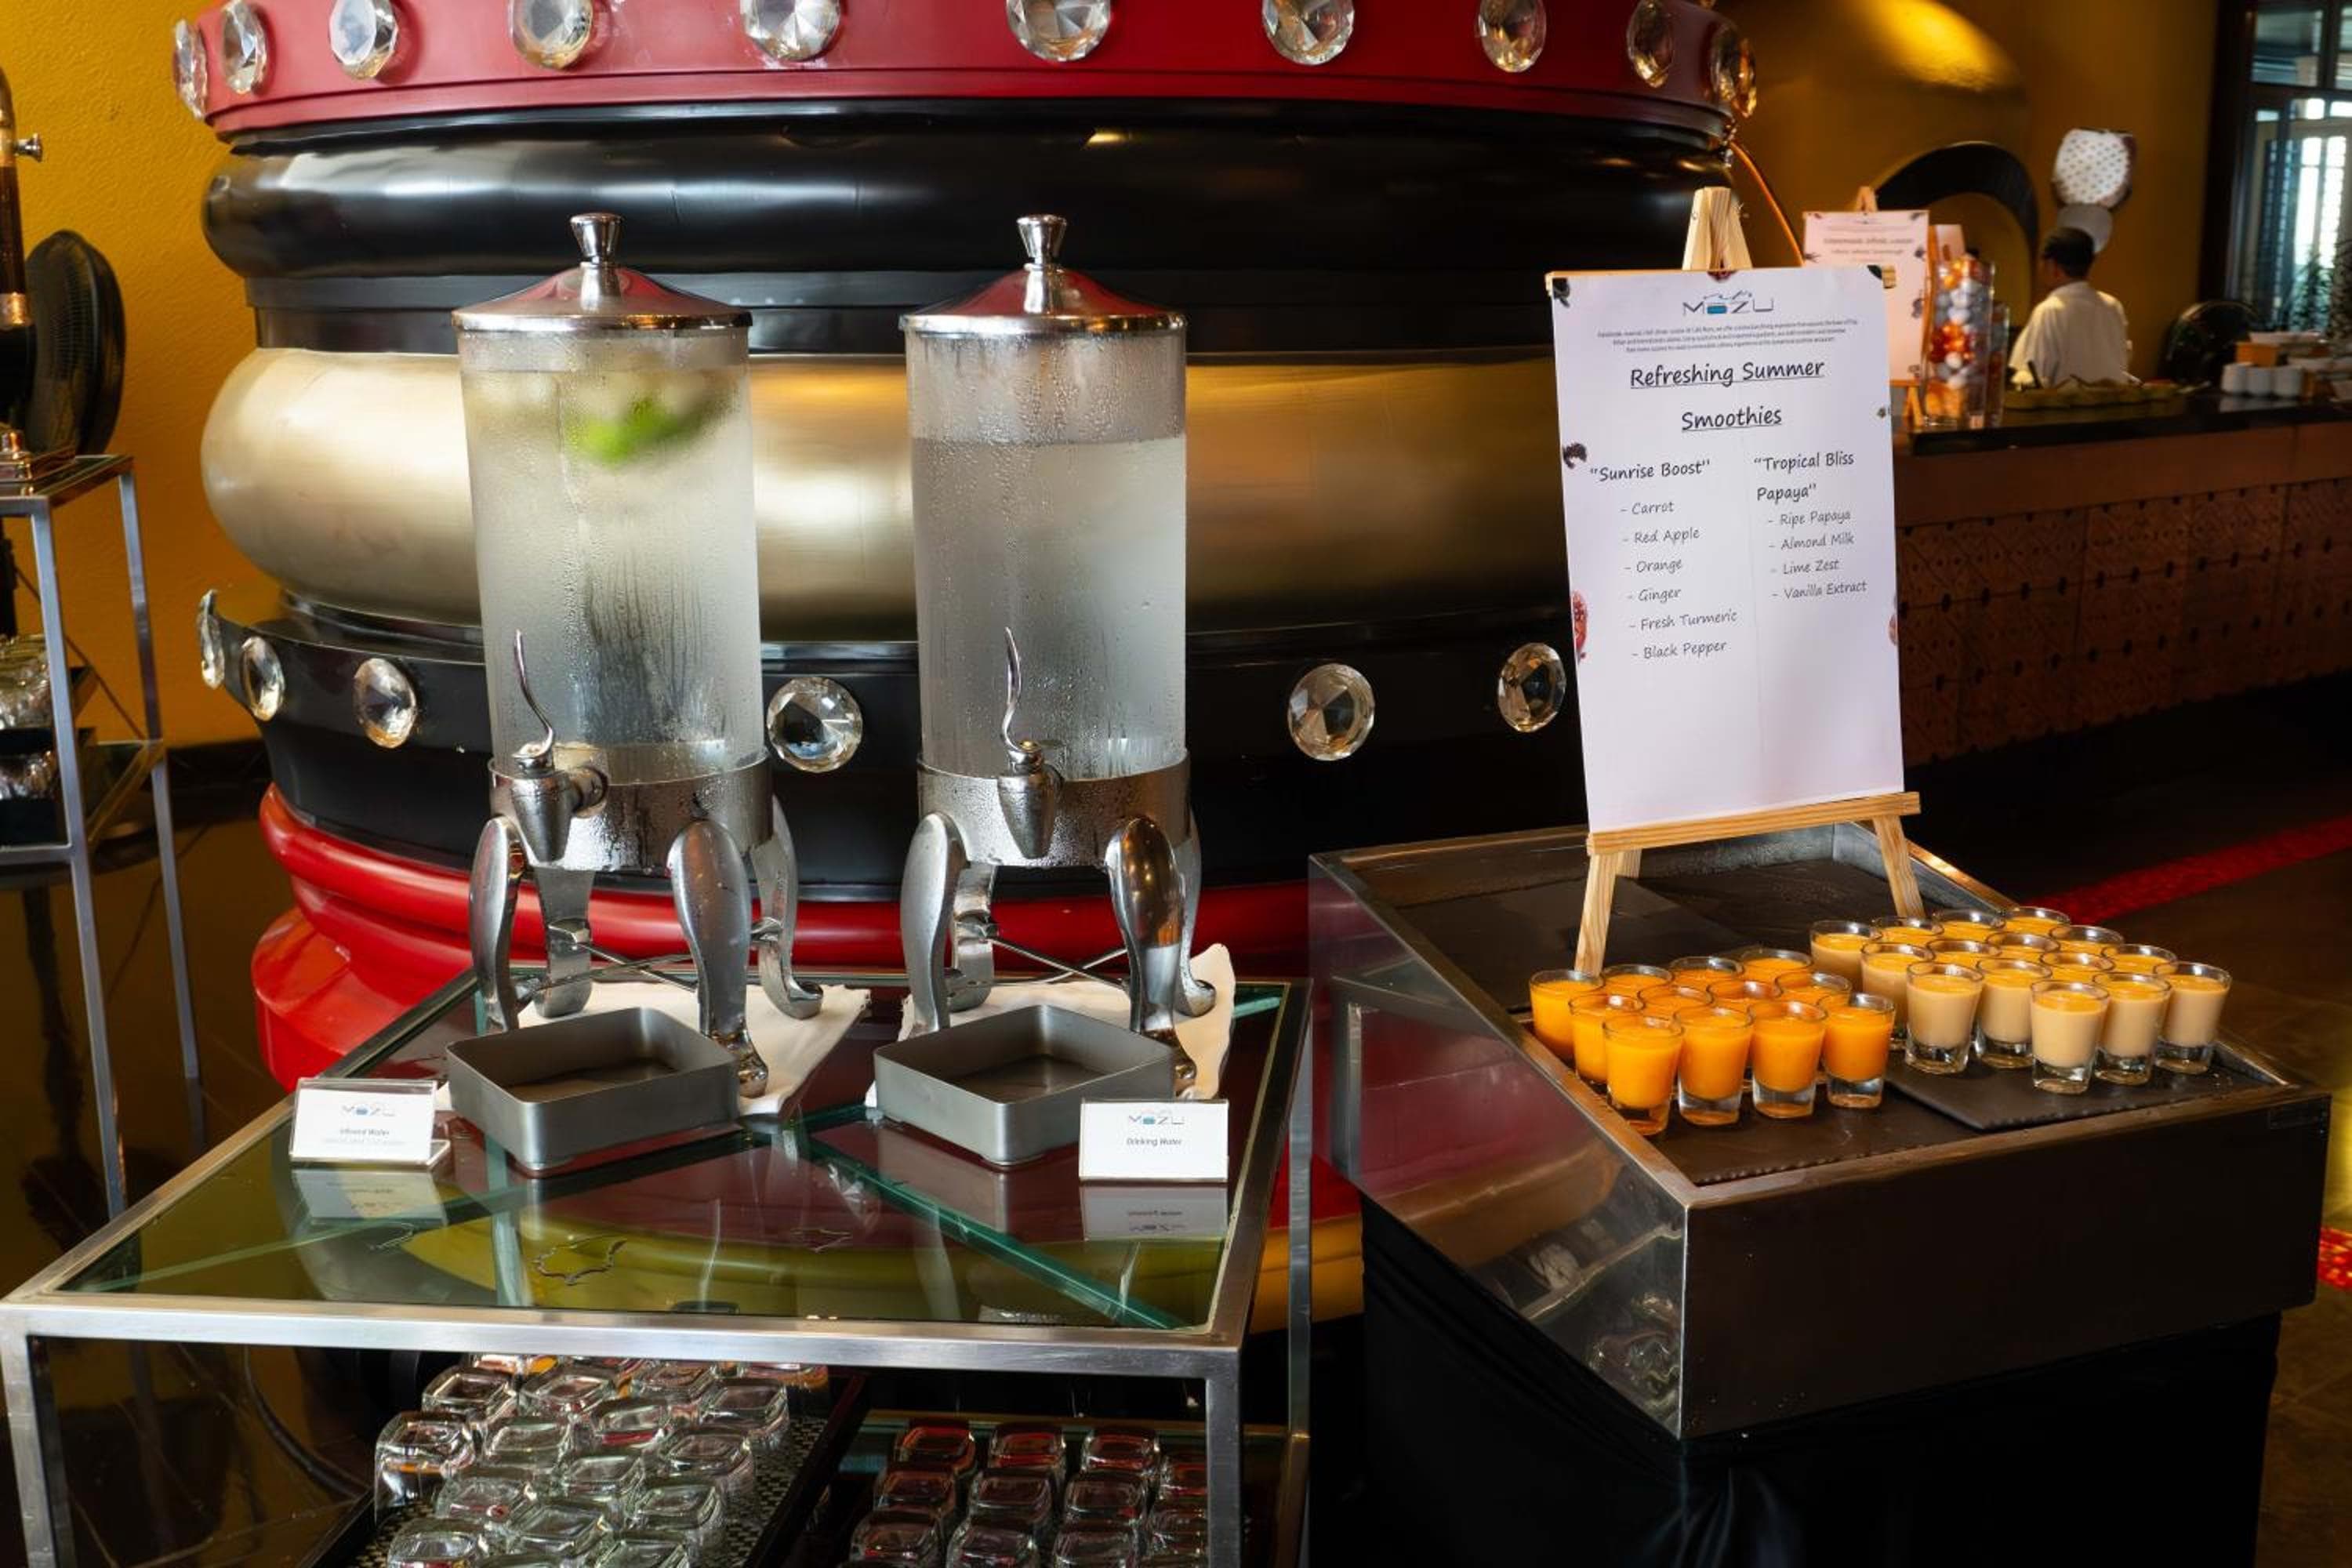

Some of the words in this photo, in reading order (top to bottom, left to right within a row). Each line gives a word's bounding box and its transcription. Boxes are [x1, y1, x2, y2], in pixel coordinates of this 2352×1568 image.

[1631, 365, 1733, 387] Refreshing
[1743, 360, 1825, 380] Summer
[1682, 406, 1782, 431] Smoothies
[1825, 451, 1855, 466] Bliss
[1632, 501, 1675, 515] Carrot
[1780, 511, 1806, 528] Ripe
[1809, 510, 1852, 525] Papaya
[1634, 529, 1658, 544] Red
[1663, 527, 1700, 546] Apple
[1780, 535, 1827, 550] Almond
[1831, 531, 1855, 546] Milk
[1636, 559, 1682, 574] Orange
[1783, 561, 1811, 575] Lime
[1815, 559, 1839, 572] Zest
[1638, 588, 1682, 604] Ginger
[1784, 583, 1823, 600] Vanilla
[1826, 580, 1867, 595] Extract
[1640, 615, 1675, 631] Fresh
[1679, 608, 1738, 626] Turmeric
[1643, 644, 1679, 659] Black
[1682, 641, 1727, 659] Pepper
[1126, 1138, 1159, 1147] Drinking
